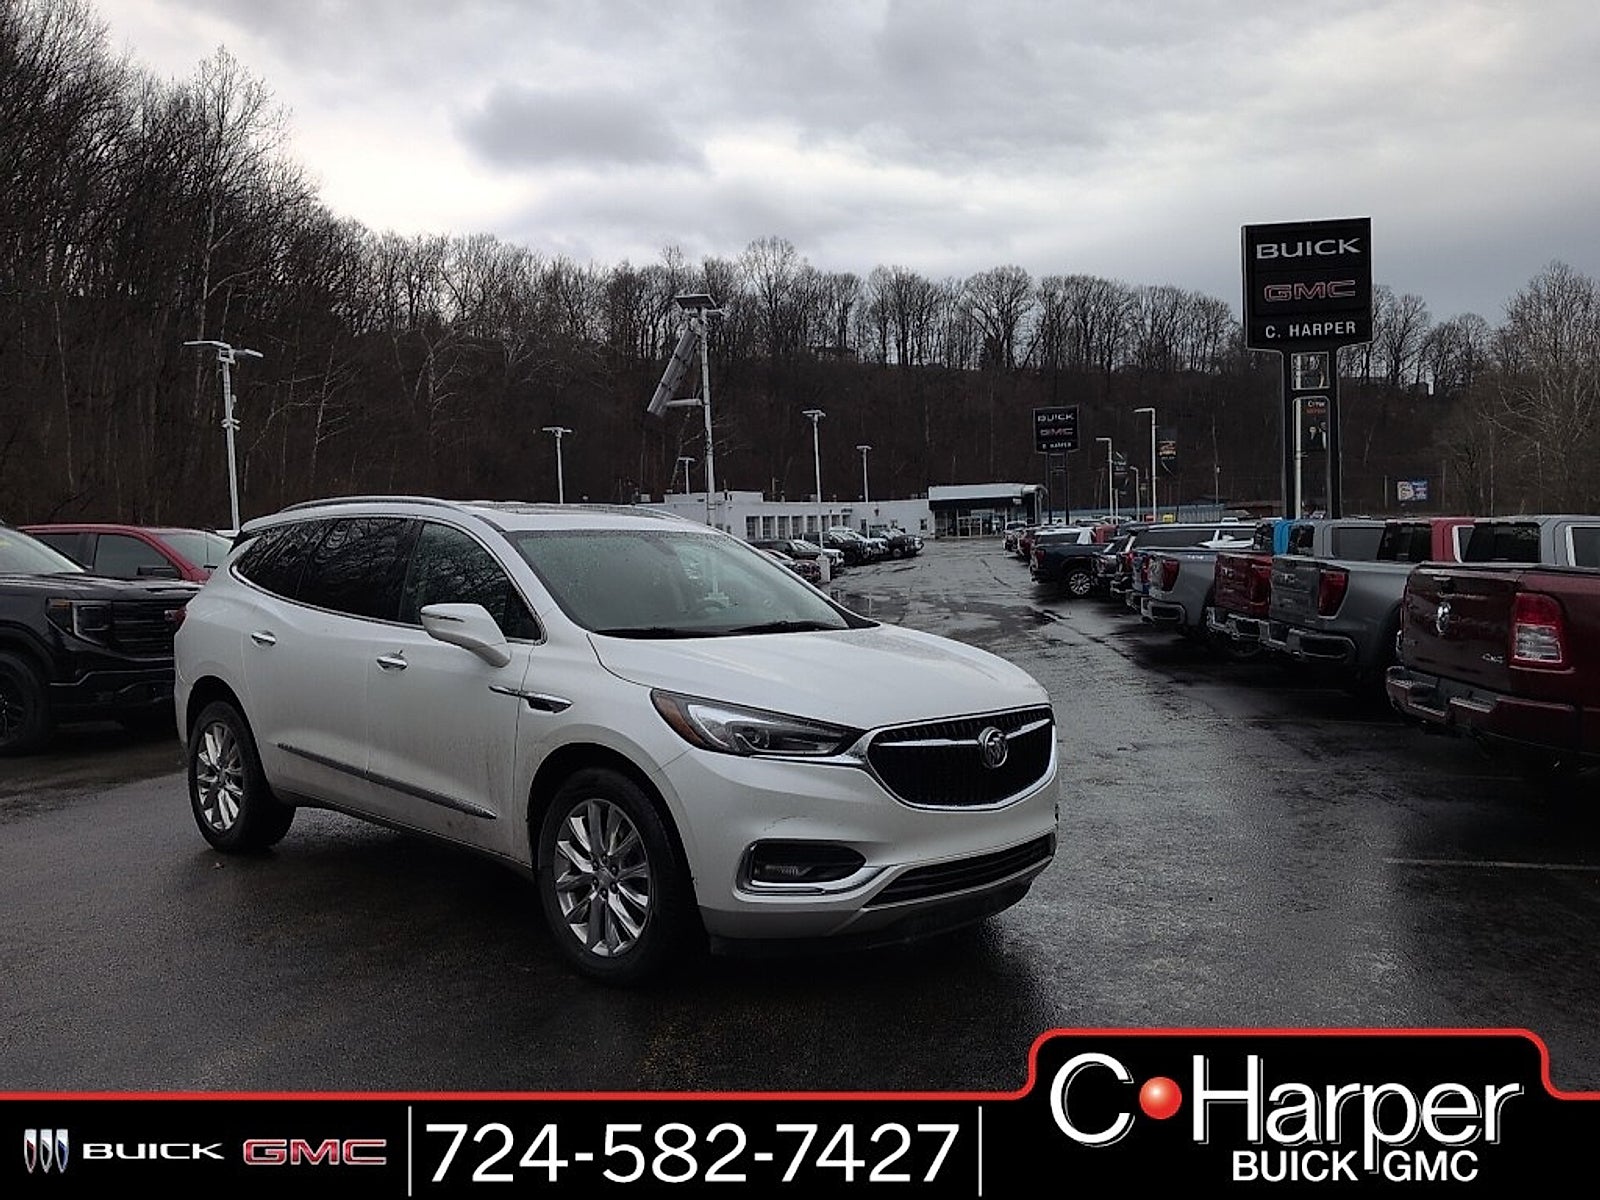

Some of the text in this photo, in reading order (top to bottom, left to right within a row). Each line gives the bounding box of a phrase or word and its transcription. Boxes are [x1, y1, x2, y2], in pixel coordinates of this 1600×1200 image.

[1256, 237, 1361, 260] BUICK
[1264, 279, 1356, 303] GMC
[1265, 320, 1356, 339] C. HARPER
